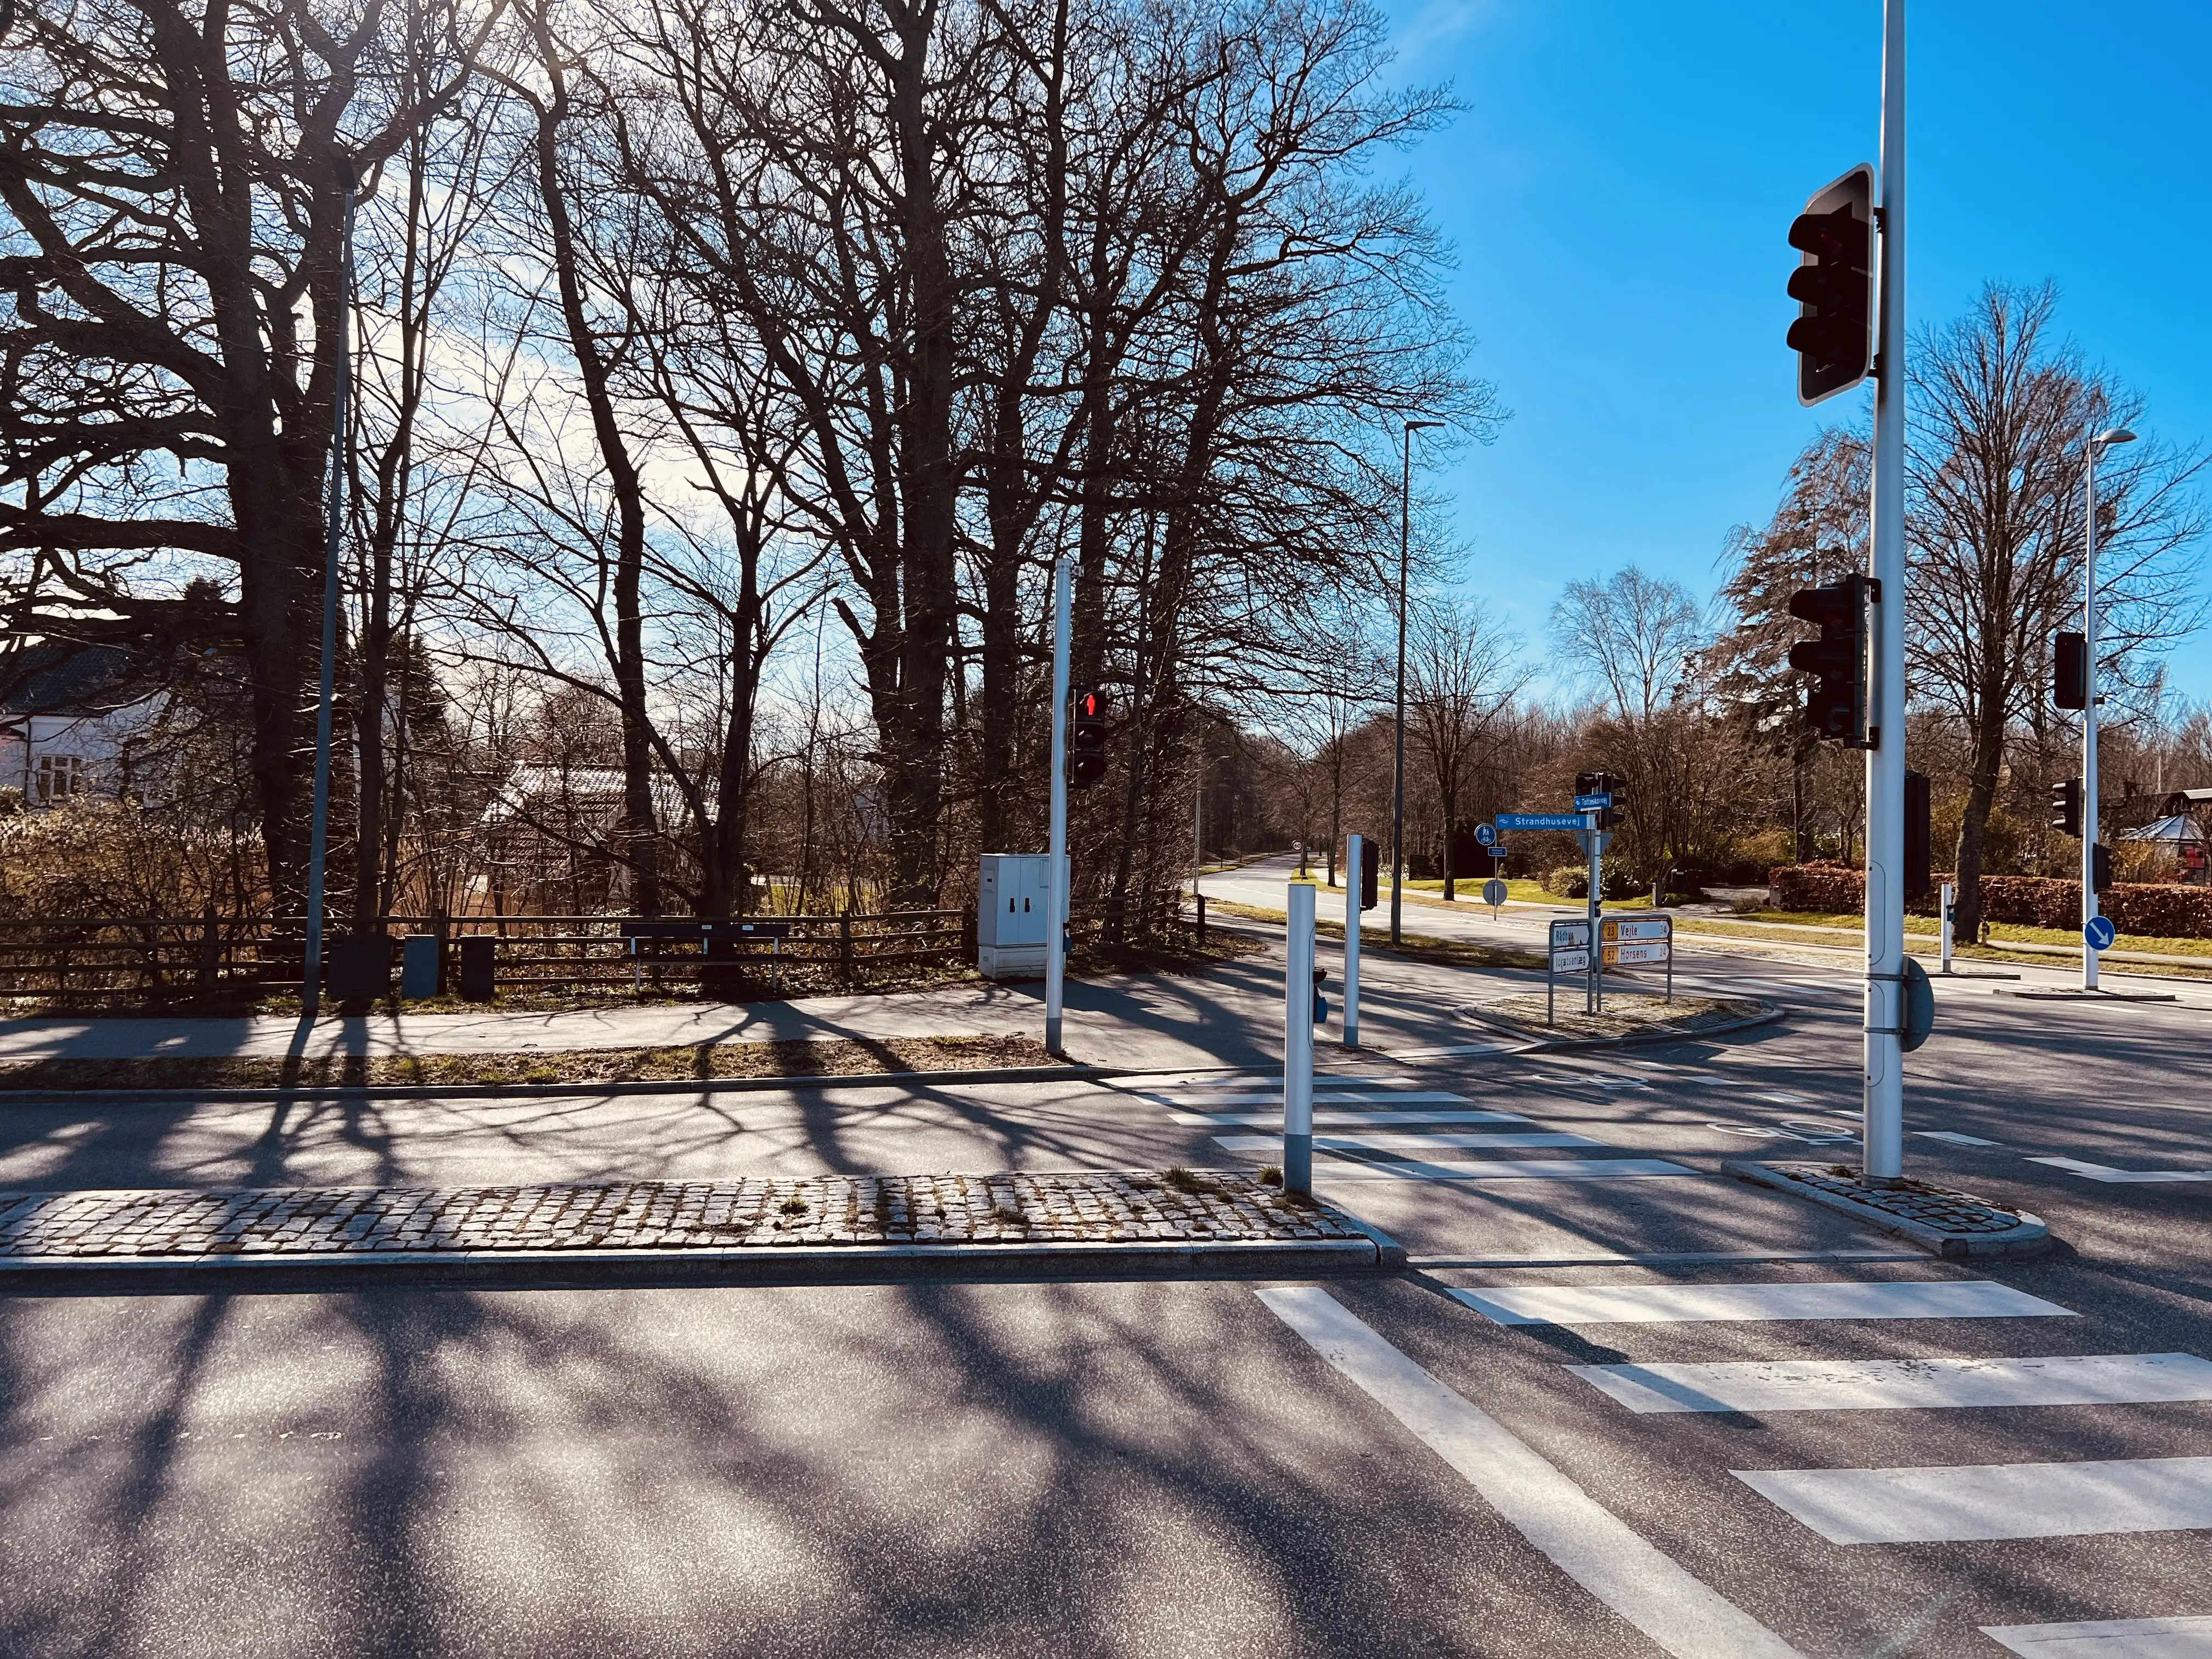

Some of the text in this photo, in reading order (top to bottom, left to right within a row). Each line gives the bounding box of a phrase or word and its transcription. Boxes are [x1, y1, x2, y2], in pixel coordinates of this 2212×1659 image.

[1515, 817, 1580, 826] Strandhusevej
[1607, 924, 1667, 938] 23 Vejle 34
[1607, 947, 1666, 961] 52 Horsens 24
